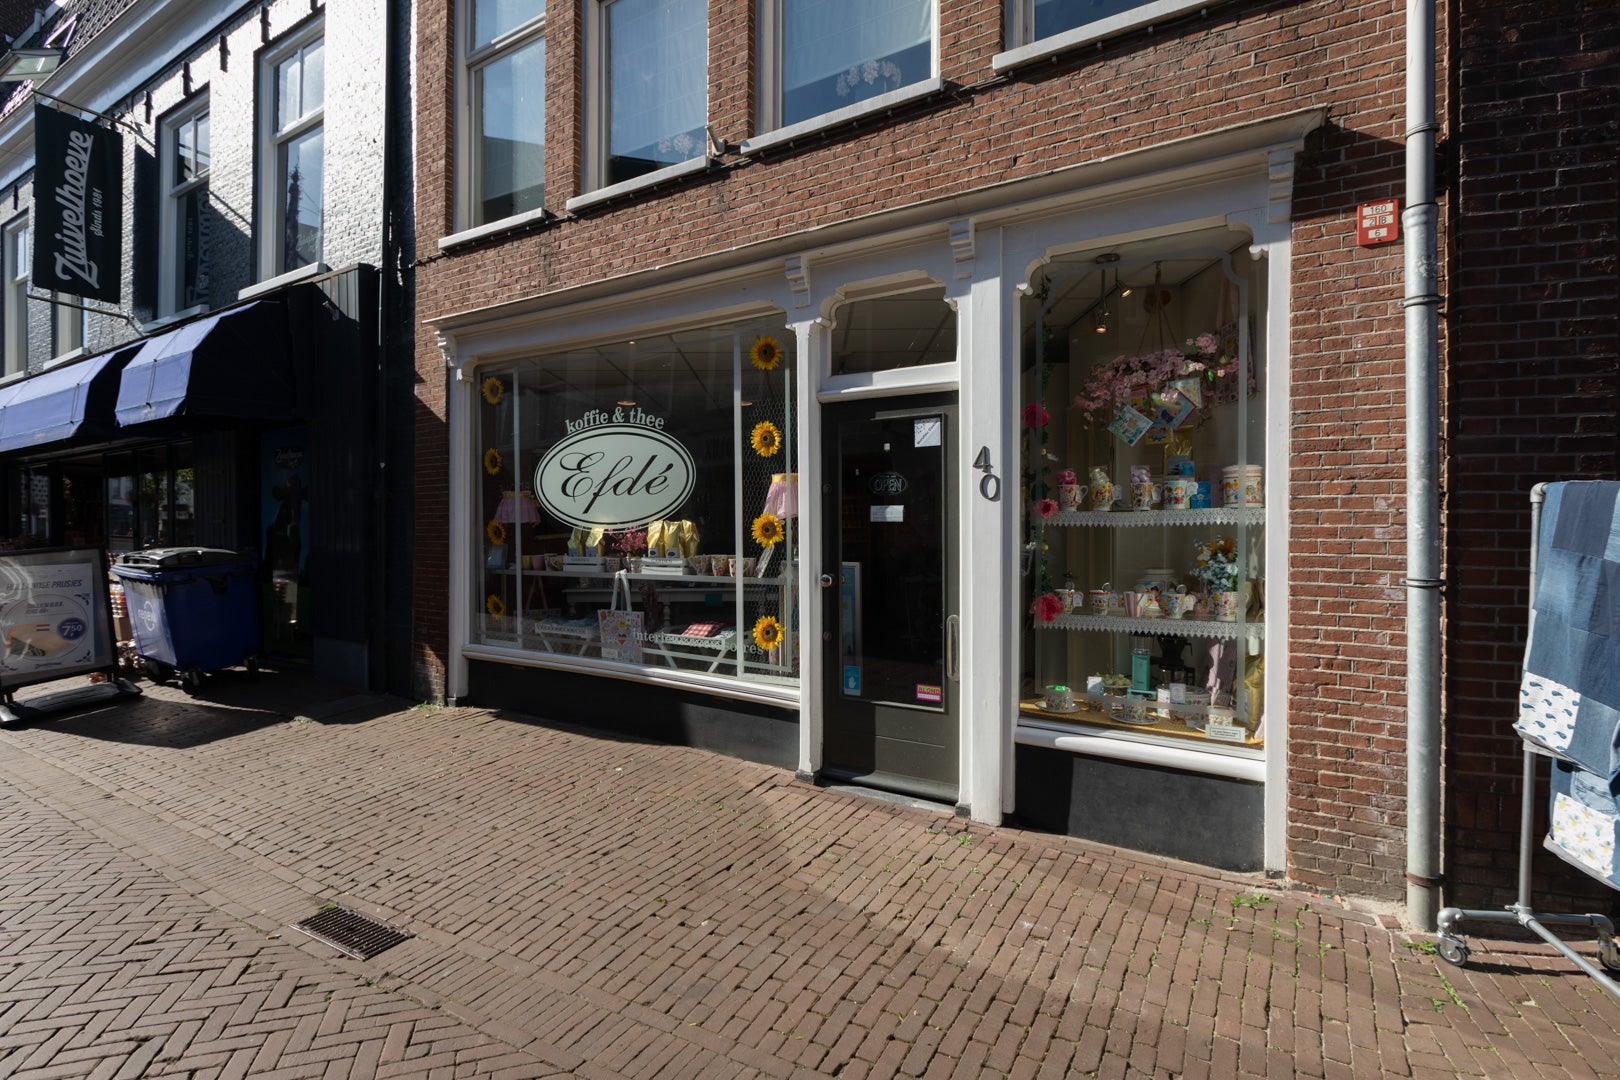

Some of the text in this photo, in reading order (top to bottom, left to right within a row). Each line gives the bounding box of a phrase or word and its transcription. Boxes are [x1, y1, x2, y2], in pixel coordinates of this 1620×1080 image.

[53, 129, 100, 290] Zuivelhoeve
[1370, 205, 1386, 213] 160
[565, 406, 665, 434] koffie & thee
[559, 451, 674, 515] Efdé
[873, 479, 902, 492] OPEN
